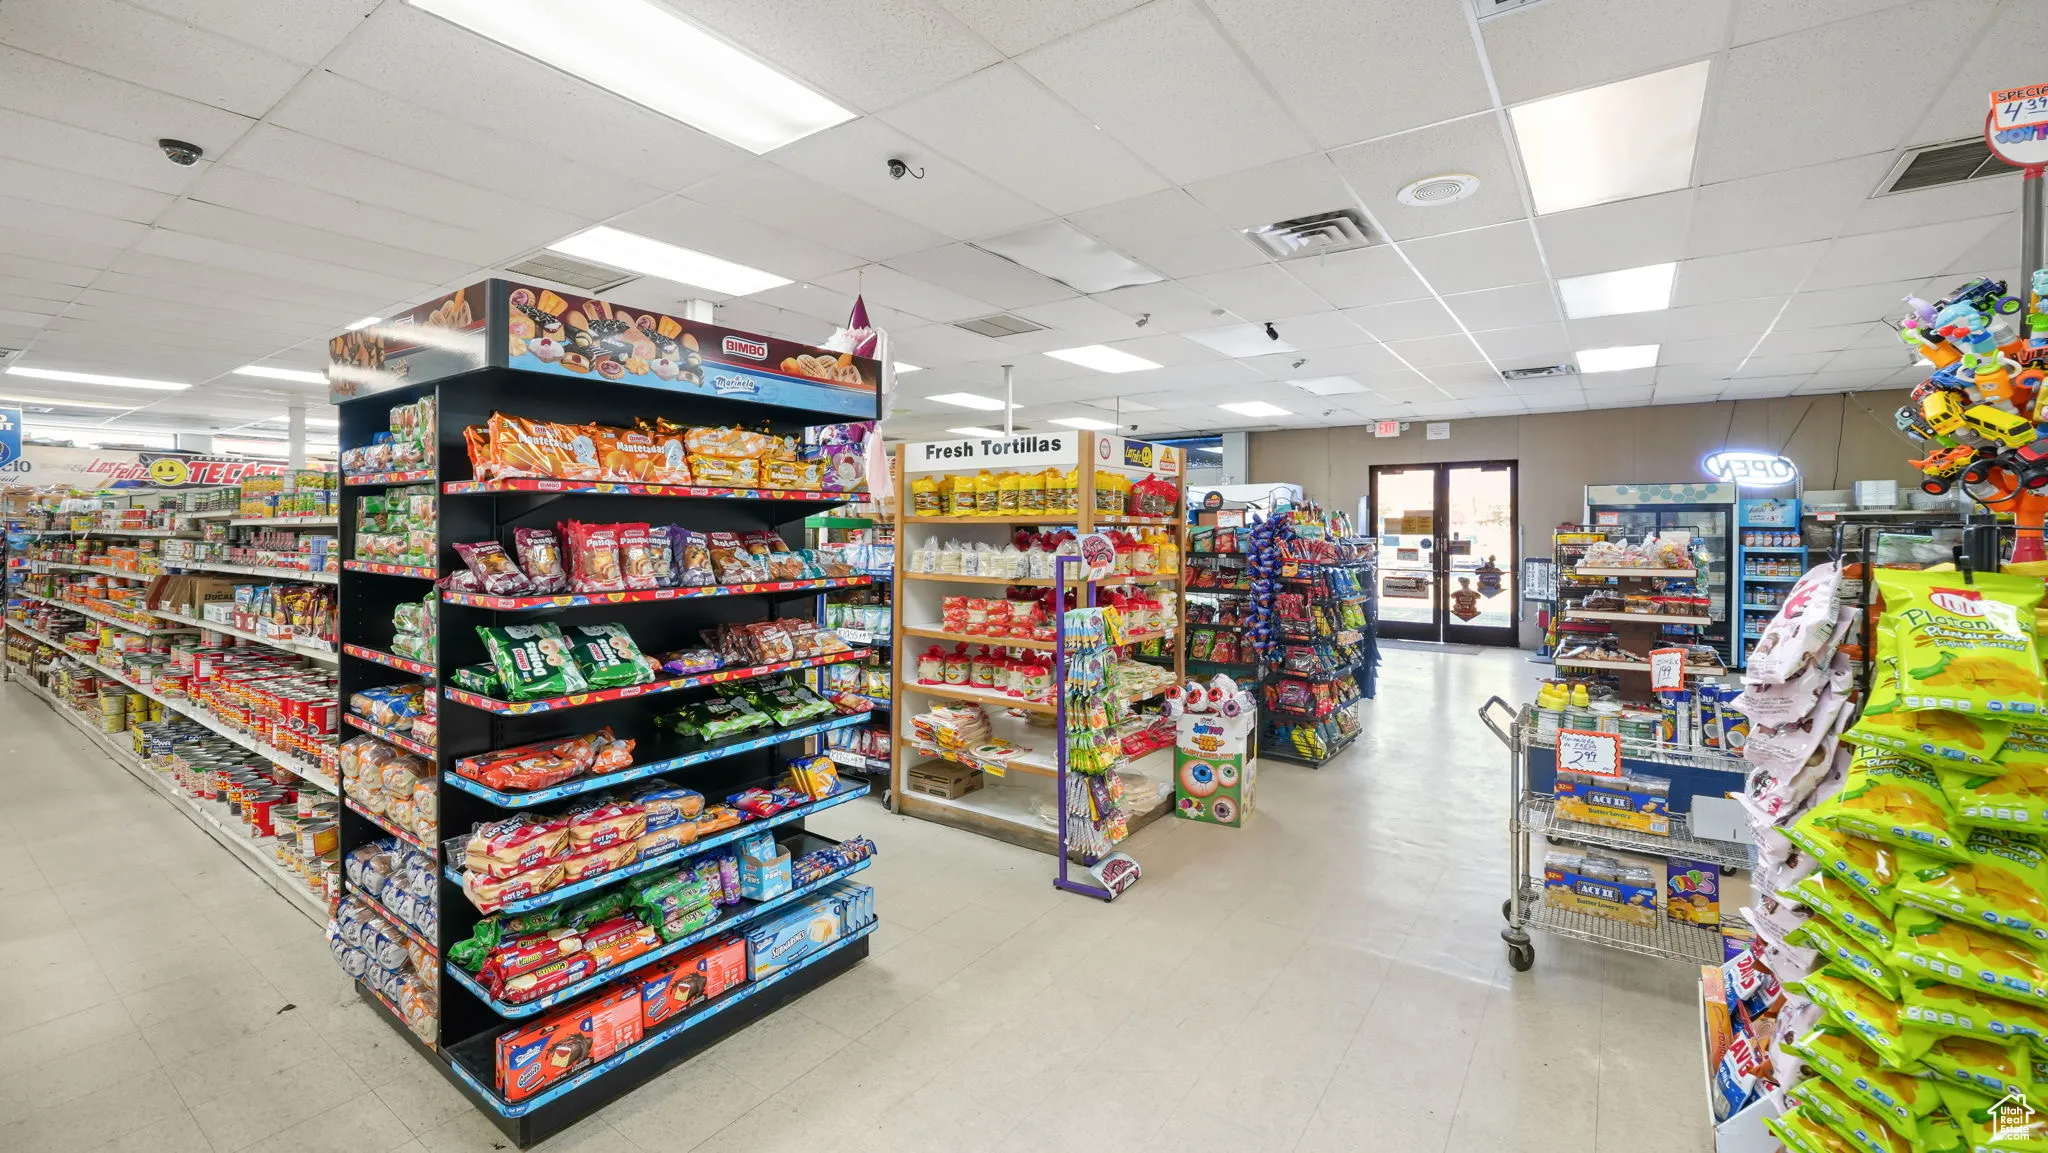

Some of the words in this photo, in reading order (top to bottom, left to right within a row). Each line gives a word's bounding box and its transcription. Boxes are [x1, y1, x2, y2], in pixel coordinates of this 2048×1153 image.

[726, 340, 765, 357] BIMBO
[716, 376, 754, 388] Marinela
[1378, 422, 1396, 433] EXIT
[518, 433, 574, 451] Mantecadas
[616, 441, 665, 453] Mantecadas
[925, 442, 974, 460] Fresh
[981, 436, 1062, 455] Tortillas
[586, 538, 617, 548] Panqu
[1901, 608, 2033, 632] Platanios
[1924, 625, 1988, 640] Plantain
[1866, 758, 1921, 772] Plantain
[1592, 794, 1612, 806] ACT
[1588, 807, 1608, 816] Butter
[1609, 810, 1632, 819] Lovers
[592, 834, 606, 844] HOT
[606, 832, 618, 841] DOG
[520, 856, 532, 865] HOT
[531, 851, 544, 862] DOG
[583, 869, 597, 877] HOT
[1668, 869, 1716, 895] POPS
[502, 892, 515, 902] HOT
[515, 887, 530, 899] DOG
[1579, 885, 1599, 896] ACT
[1576, 897, 1597, 907] Butter
[1597, 901, 1620, 912] Lovers
